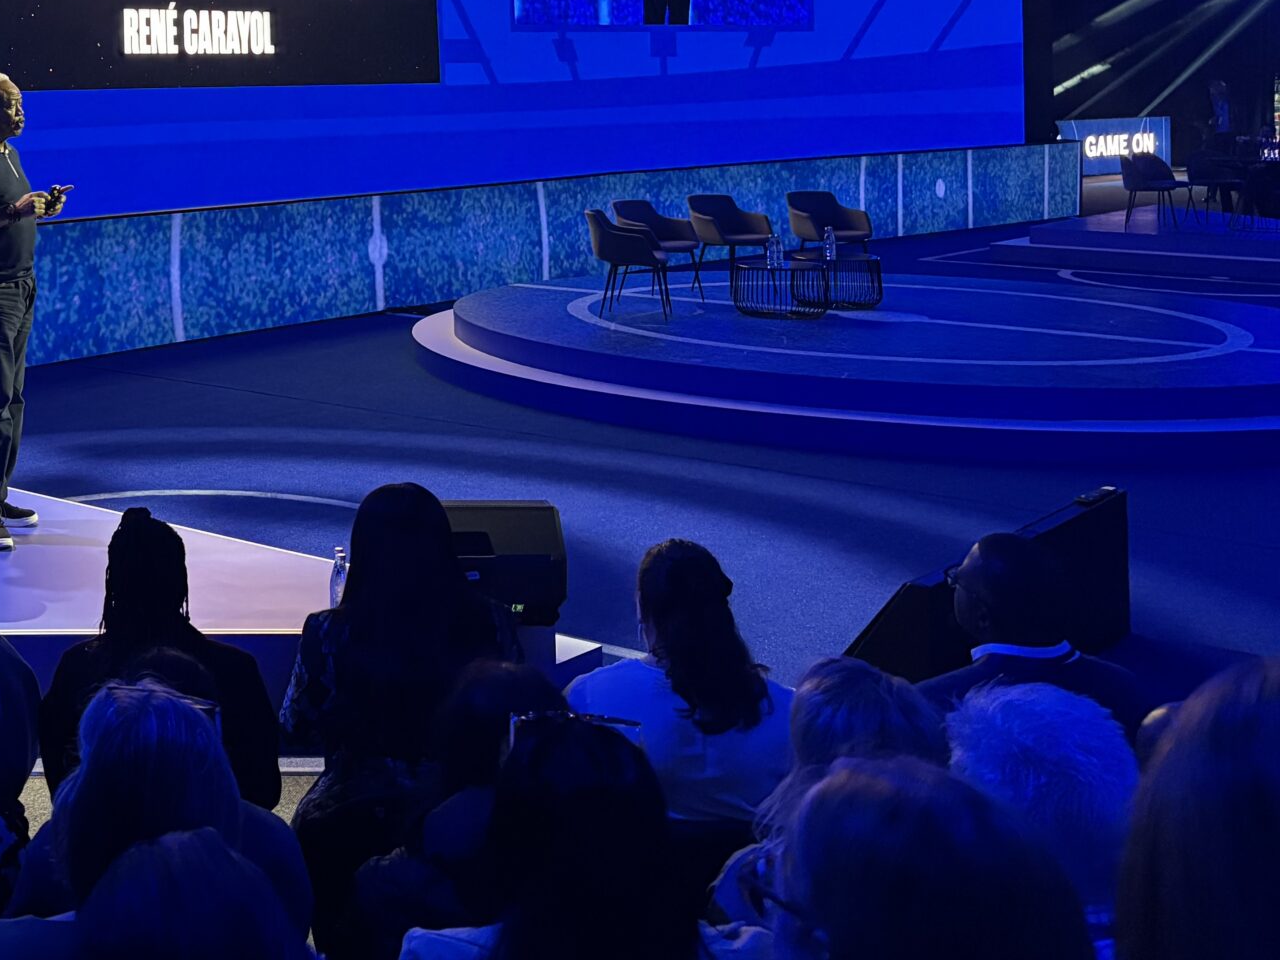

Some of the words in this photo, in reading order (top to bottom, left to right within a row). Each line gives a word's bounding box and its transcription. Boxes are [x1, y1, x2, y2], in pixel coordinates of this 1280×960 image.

[123, 2, 179, 55] RENÉ
[183, 8, 275, 55] CARAYOL
[1085, 134, 1129, 157] GAME
[1132, 133, 1154, 153] ON
